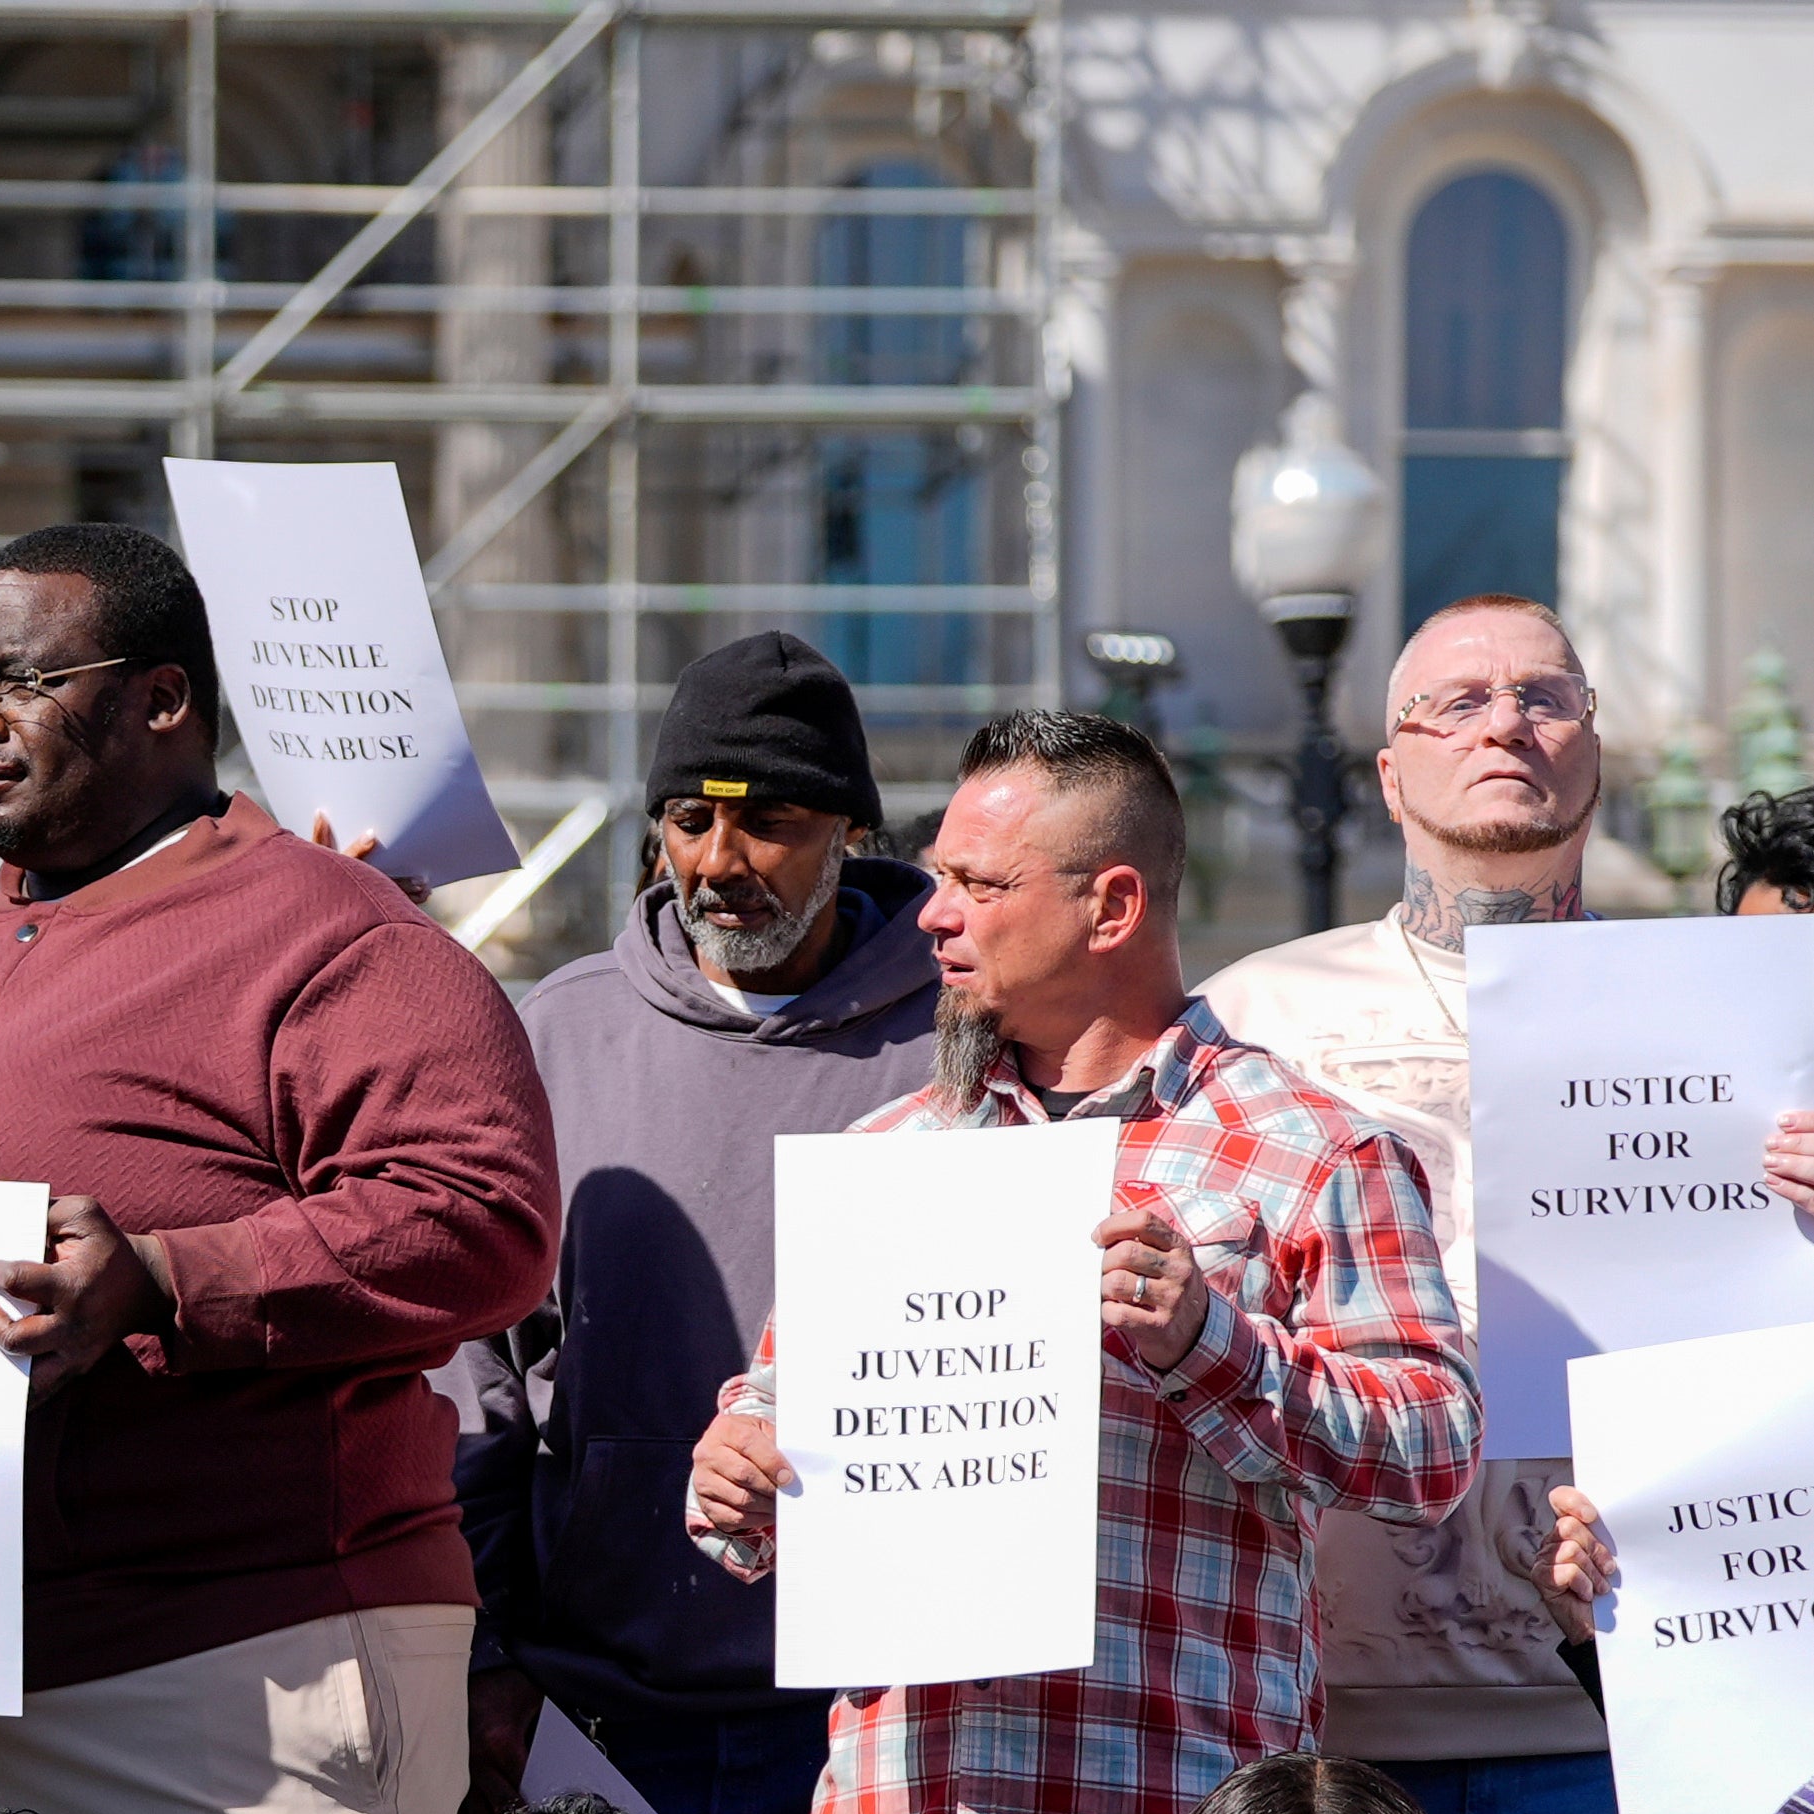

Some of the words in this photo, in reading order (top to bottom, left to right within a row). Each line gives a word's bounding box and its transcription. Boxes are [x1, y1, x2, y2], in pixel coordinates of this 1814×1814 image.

[271, 599, 338, 621] STOP
[251, 640, 388, 670] JUVENILE
[252, 685, 412, 714] DETENTION
[268, 728, 313, 758] SEX
[319, 732, 419, 762] ABUSE
[1561, 1075, 1732, 1108] JUSTICE
[1609, 1132, 1691, 1160] FOR
[1530, 1181, 1770, 1217] SURVIVORS
[906, 1289, 1005, 1322] STOP
[851, 1340, 1046, 1381] JUVENILE
[833, 1393, 1060, 1437] DETENTION
[845, 1463, 920, 1493] SEX
[931, 1450, 1048, 1487] ABUSE
[1668, 1486, 1814, 1534] JUSTIC
[1722, 1545, 1808, 1581] FOR
[1655, 1599, 1814, 1648] SURVIV
